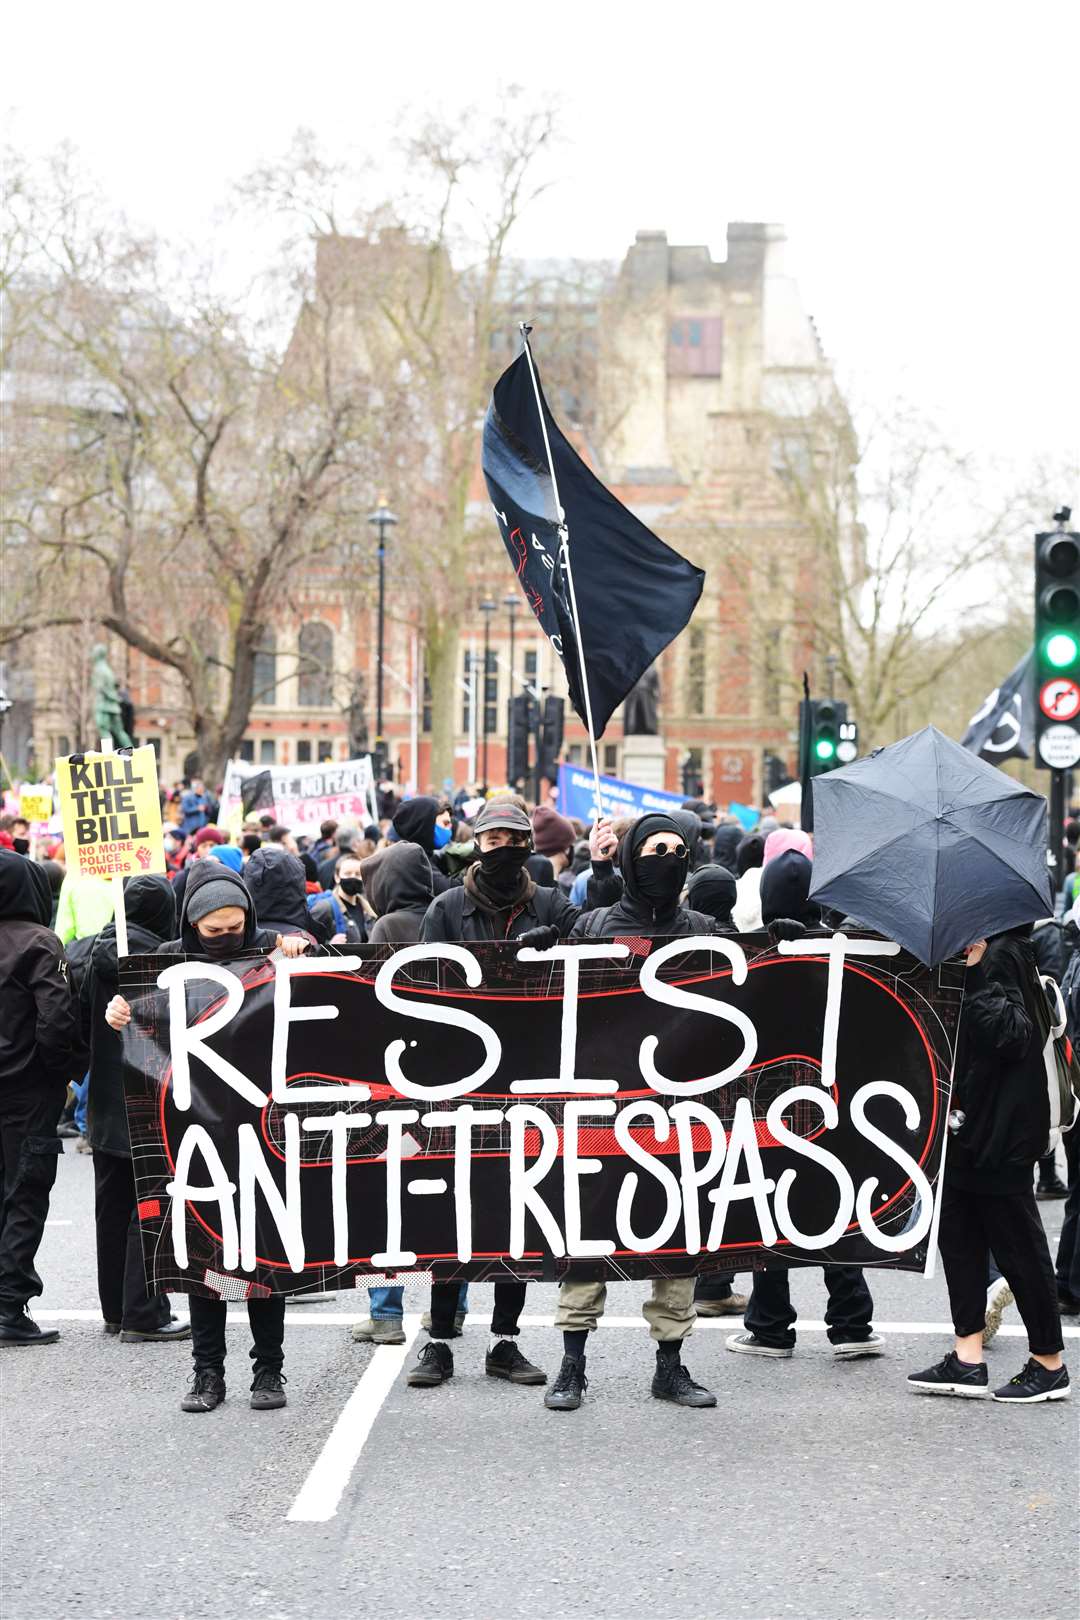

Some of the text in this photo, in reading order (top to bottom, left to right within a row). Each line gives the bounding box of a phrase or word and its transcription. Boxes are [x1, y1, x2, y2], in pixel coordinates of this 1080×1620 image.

[70, 760, 143, 790] KILL
[71, 787, 135, 817] THE
[76, 814, 149, 845] BILL
[78, 841, 134, 856] NO MORE
[79, 853, 121, 866] POLICE
[80, 862, 131, 876] POWERS
[157, 933, 900, 1111] RESIST
[166, 1081, 933, 1272] ANTI-TRESPASS
